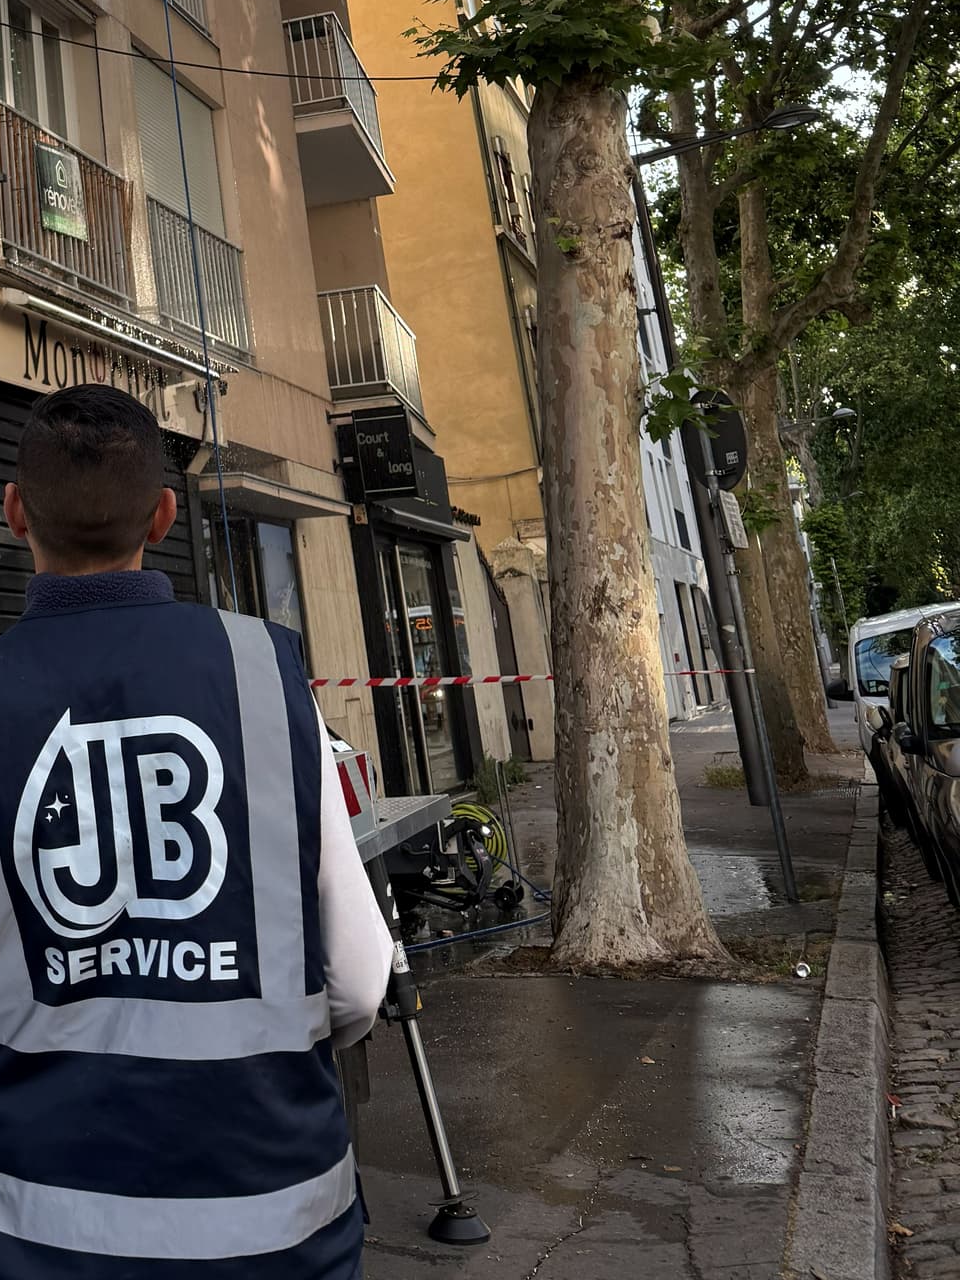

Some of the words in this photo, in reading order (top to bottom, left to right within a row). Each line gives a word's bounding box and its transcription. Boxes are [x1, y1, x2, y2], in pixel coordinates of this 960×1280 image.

[356, 432, 389, 445] Court
[377, 448, 384, 457] &
[388, 461, 413, 475] long
[44, 938, 239, 985] SERVICE
